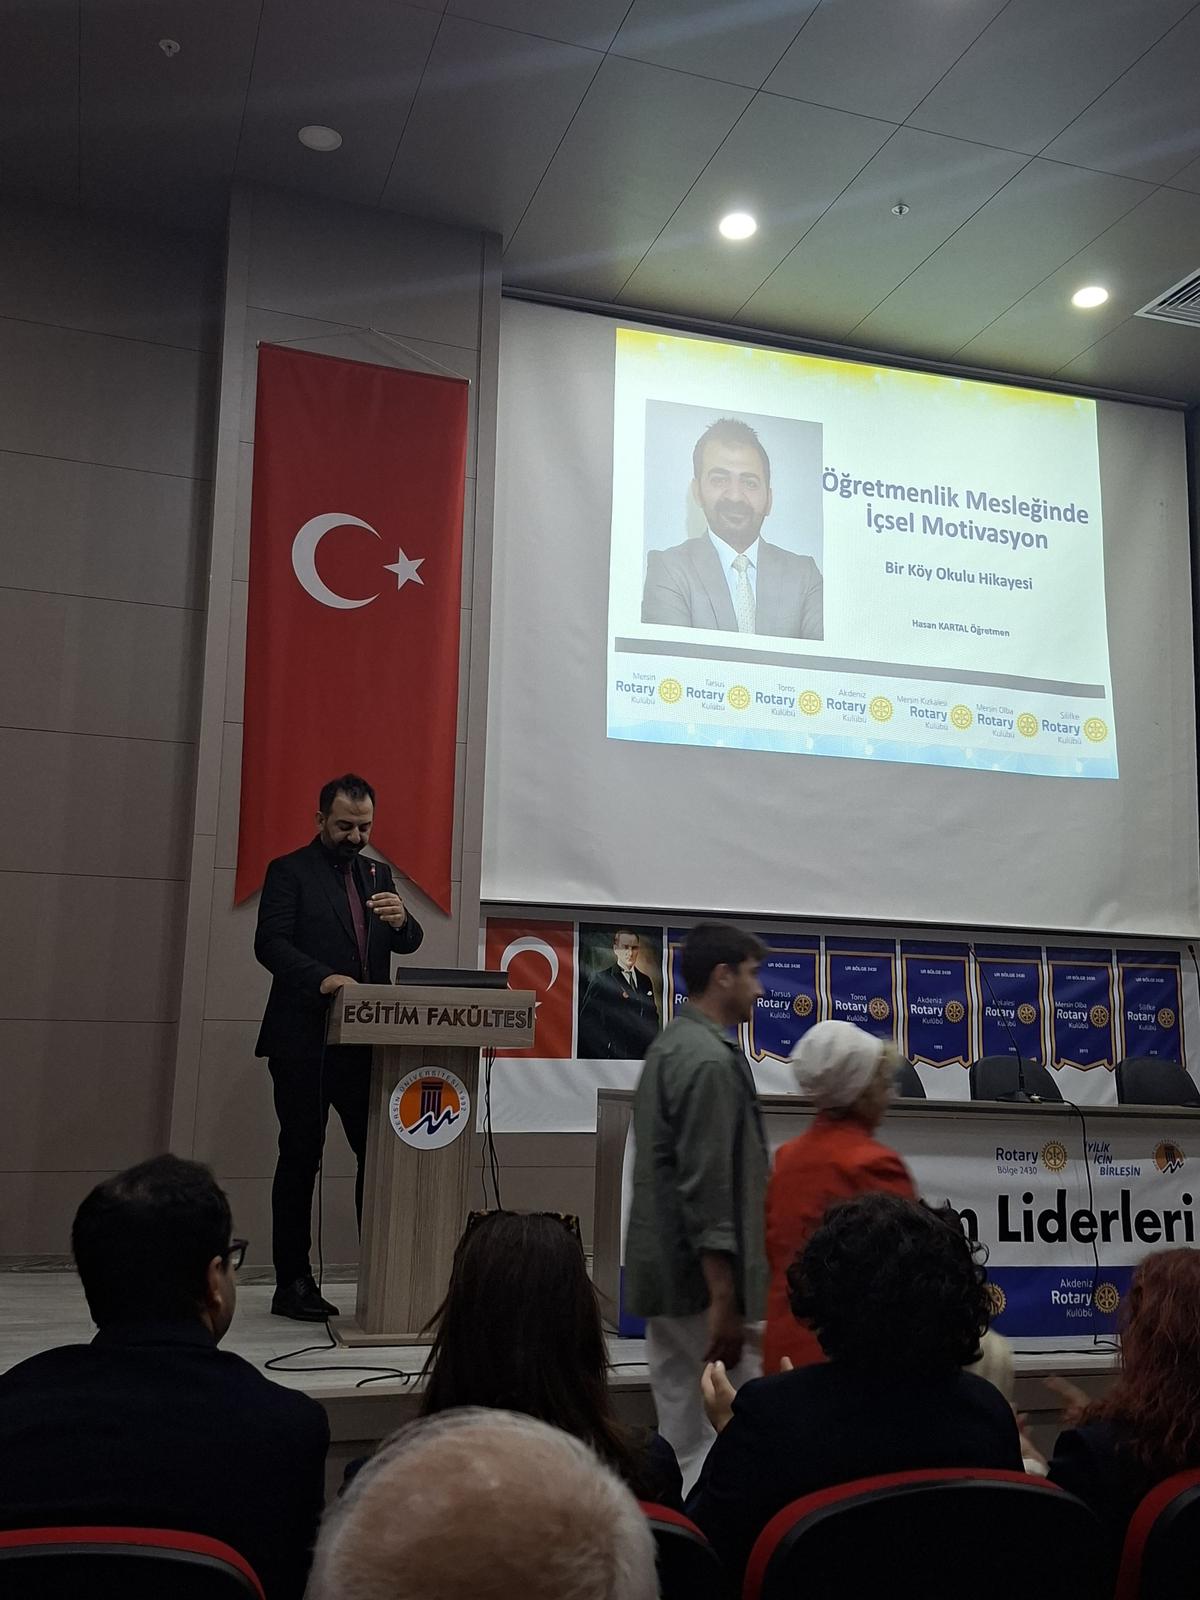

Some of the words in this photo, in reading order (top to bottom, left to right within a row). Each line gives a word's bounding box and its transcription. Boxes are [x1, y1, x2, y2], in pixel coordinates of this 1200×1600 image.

[821, 467, 960, 508] Öğretmenlik
[965, 489, 1089, 525] Mesleğinde
[866, 502, 915, 533] İçsel
[921, 510, 1049, 551] Motivasyon
[884, 561, 905, 577] Bir
[907, 563, 933, 582] Köy
[935, 565, 975, 586] Okulu
[978, 569, 1033, 592] Hikayesi
[912, 619, 937, 631] Hasan
[938, 621, 968, 633] KARTAL
[969, 623, 1010, 637] Öğretmen
[632, 672, 656, 682] Mersin
[616, 680, 655, 696] Rotary
[686, 687, 725, 703] Rotary
[838, 689, 866, 699] Akdeniz
[755, 692, 795, 708] Rotary
[826, 698, 866, 715] Rotary
[910, 706, 948, 722] Rotary
[977, 713, 1014, 730] Rotary
[1041, 719, 1080, 736] Rotary
[770, 990, 791, 998] Tarsus
[850, 993, 867, 1001] Toros
[757, 997, 790, 1012] Rotary
[835, 1000, 868, 1013] Rotary
[910, 1004, 943, 1017] Rotary
[343, 1001, 419, 1025] EĞİTİM
[427, 1005, 533, 1029] FAKÜLTESİ
[1056, 1009, 1088, 1021] Rotary
[1127, 1011, 1156, 1024] Rotary
[996, 1147, 1039, 1164] Rotary
[997, 1166, 1018, 1176] Bölge
[1020, 1166, 1037, 1175] 2430
[1100, 1164, 1141, 1177] BİRLEŞİN
[998, 1189, 1195, 1243] Liderleri
[1060, 1278, 1093, 1288] Akdeniz
[1051, 1290, 1093, 1307] Rotary
